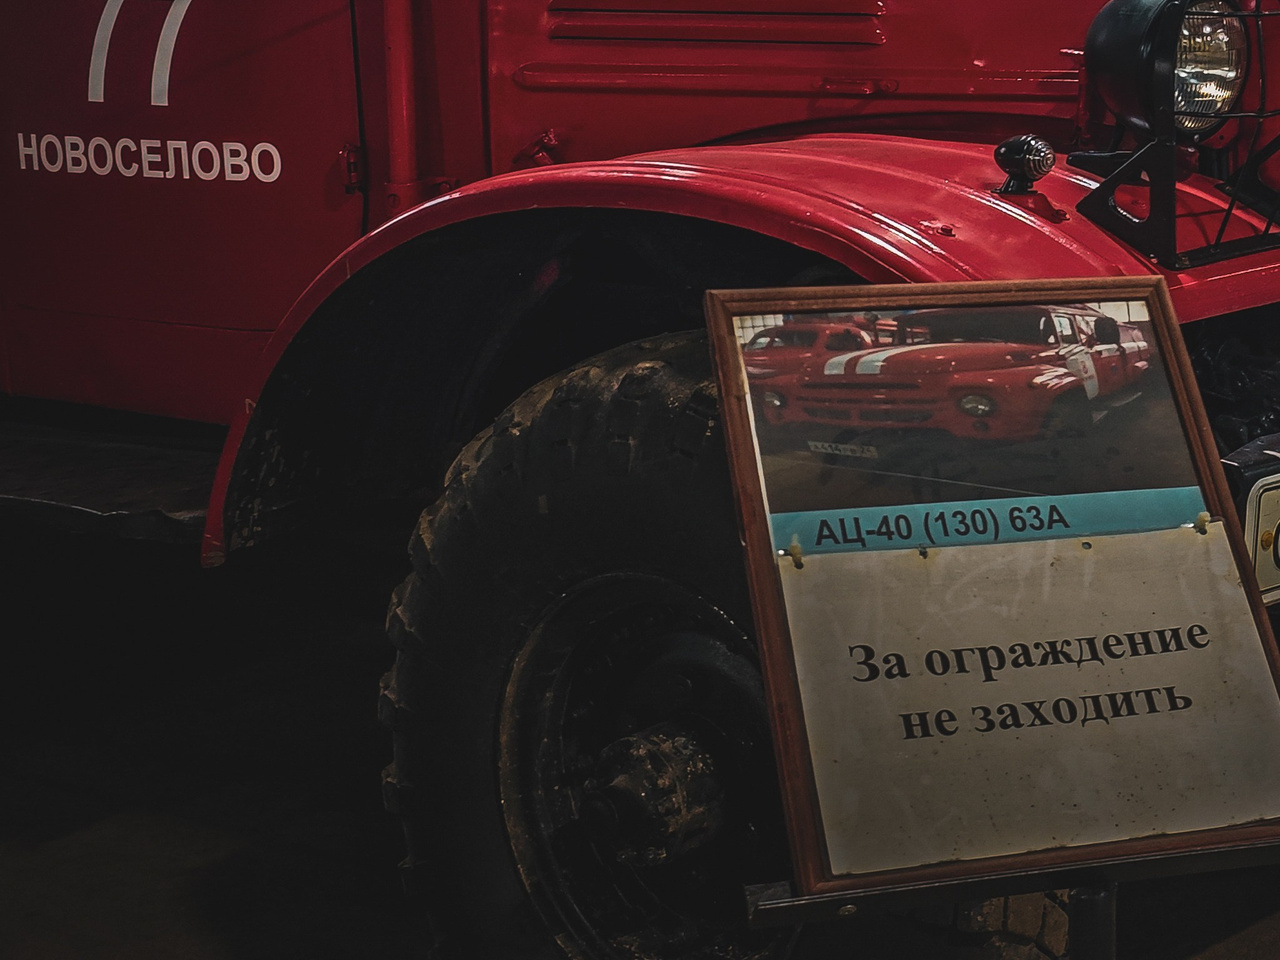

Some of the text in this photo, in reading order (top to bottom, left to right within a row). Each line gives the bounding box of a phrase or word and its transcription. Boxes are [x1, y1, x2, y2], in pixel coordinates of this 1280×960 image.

[18, 133, 281, 183] НОВОСЕЛОВО
[815, 504, 1070, 548] АЦ-40 (130) 63А
[848, 622, 1211, 683] За ограждение
[899, 684, 1193, 740] не заходить
